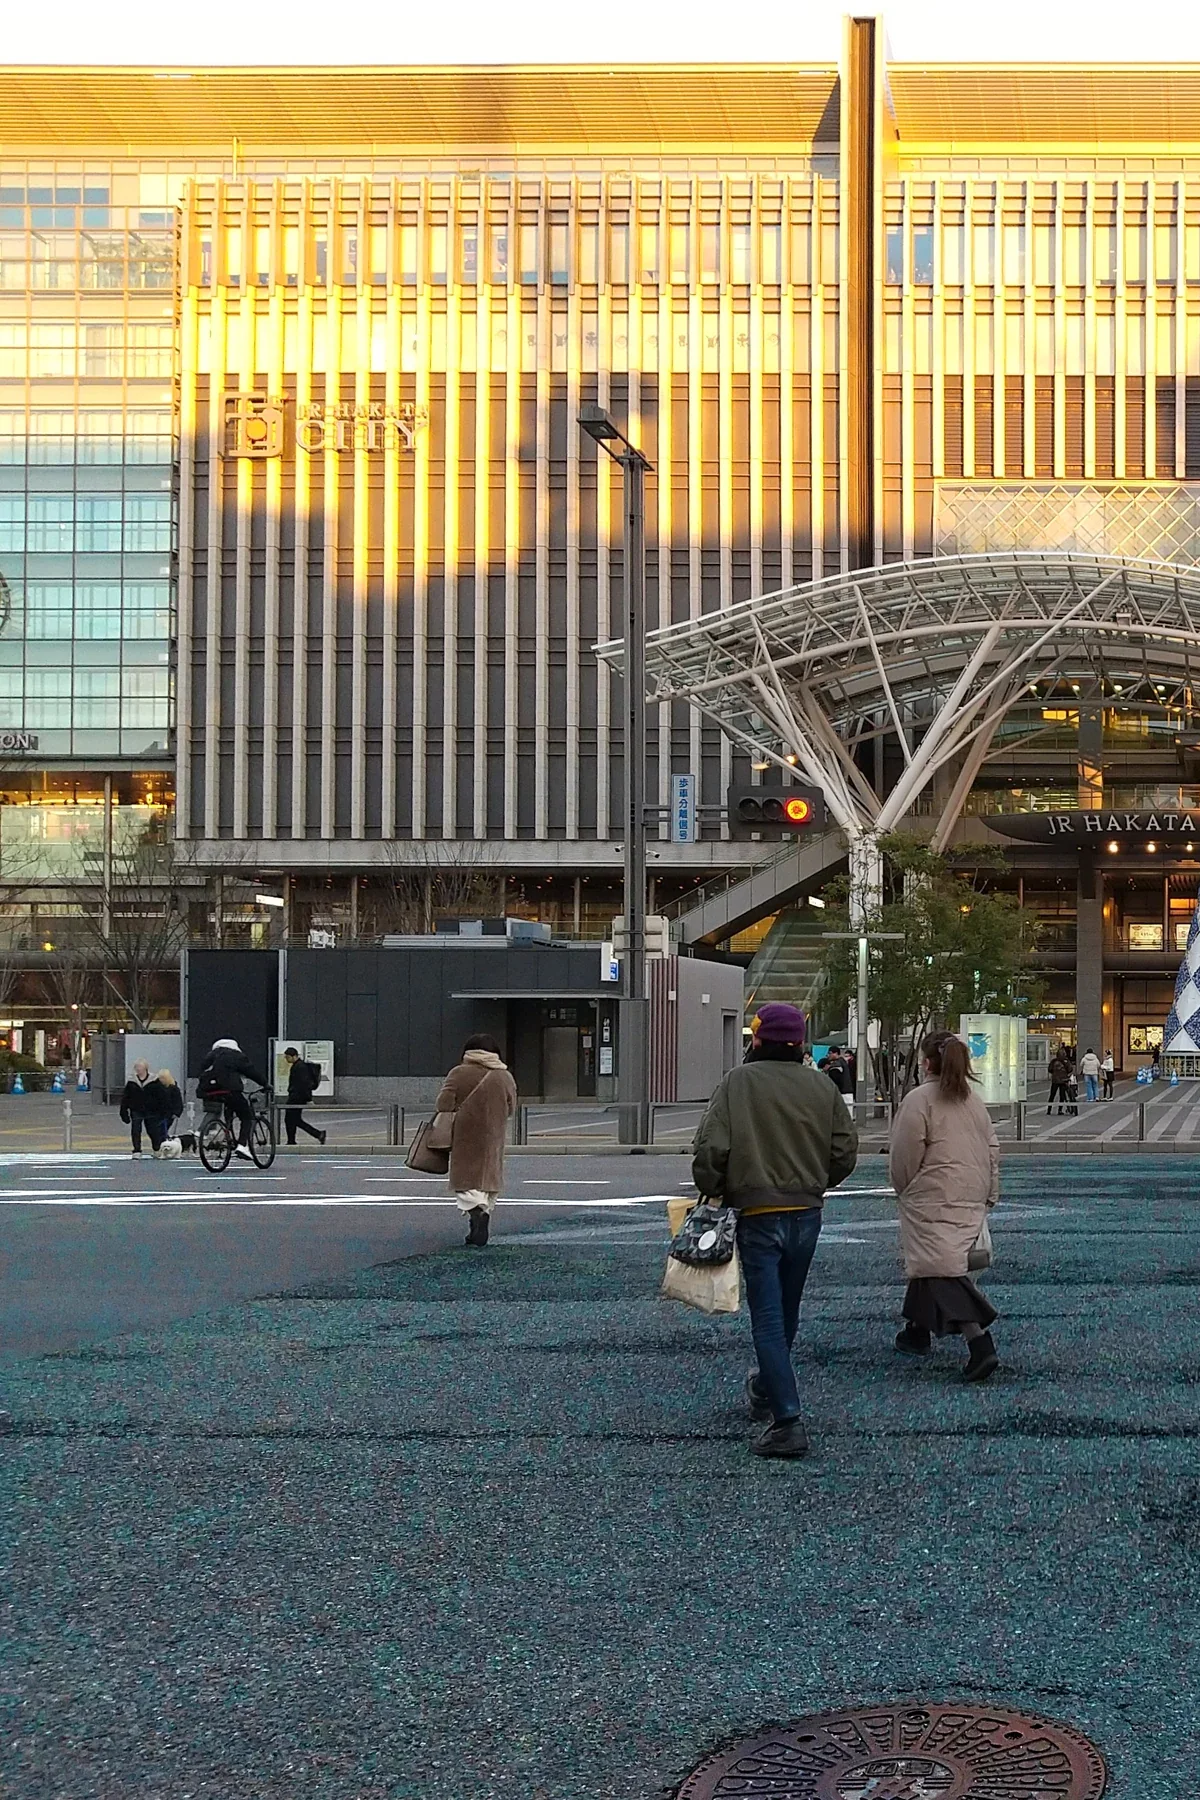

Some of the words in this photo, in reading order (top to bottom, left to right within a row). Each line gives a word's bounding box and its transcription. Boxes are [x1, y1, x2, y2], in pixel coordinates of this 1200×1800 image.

[299, 402, 322, 419] JR
[335, 402, 429, 418] HAKATA
[295, 420, 427, 451] CITY
[1047, 815, 1075, 835] JR
[1083, 814, 1197, 832] HAKATA
